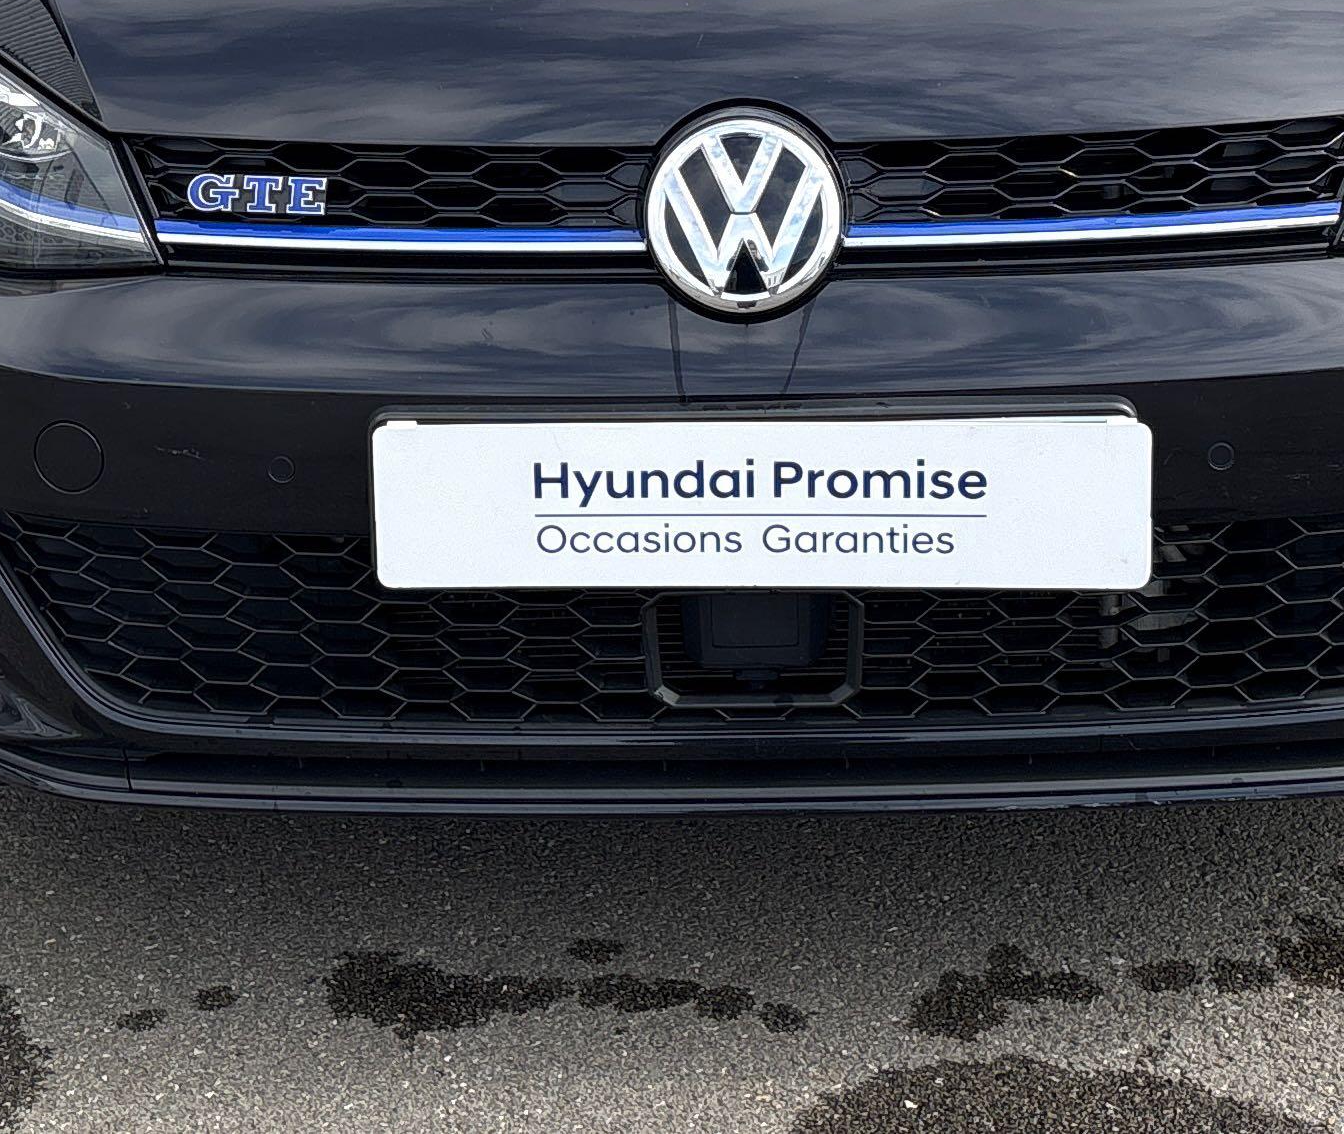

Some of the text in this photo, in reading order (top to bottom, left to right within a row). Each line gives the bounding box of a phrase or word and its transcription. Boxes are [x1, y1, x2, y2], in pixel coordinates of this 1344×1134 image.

[187, 173, 328, 216] GTE
[533, 458, 988, 508] Hyundai Promise
[536, 522, 955, 554] Occasions Garanties
